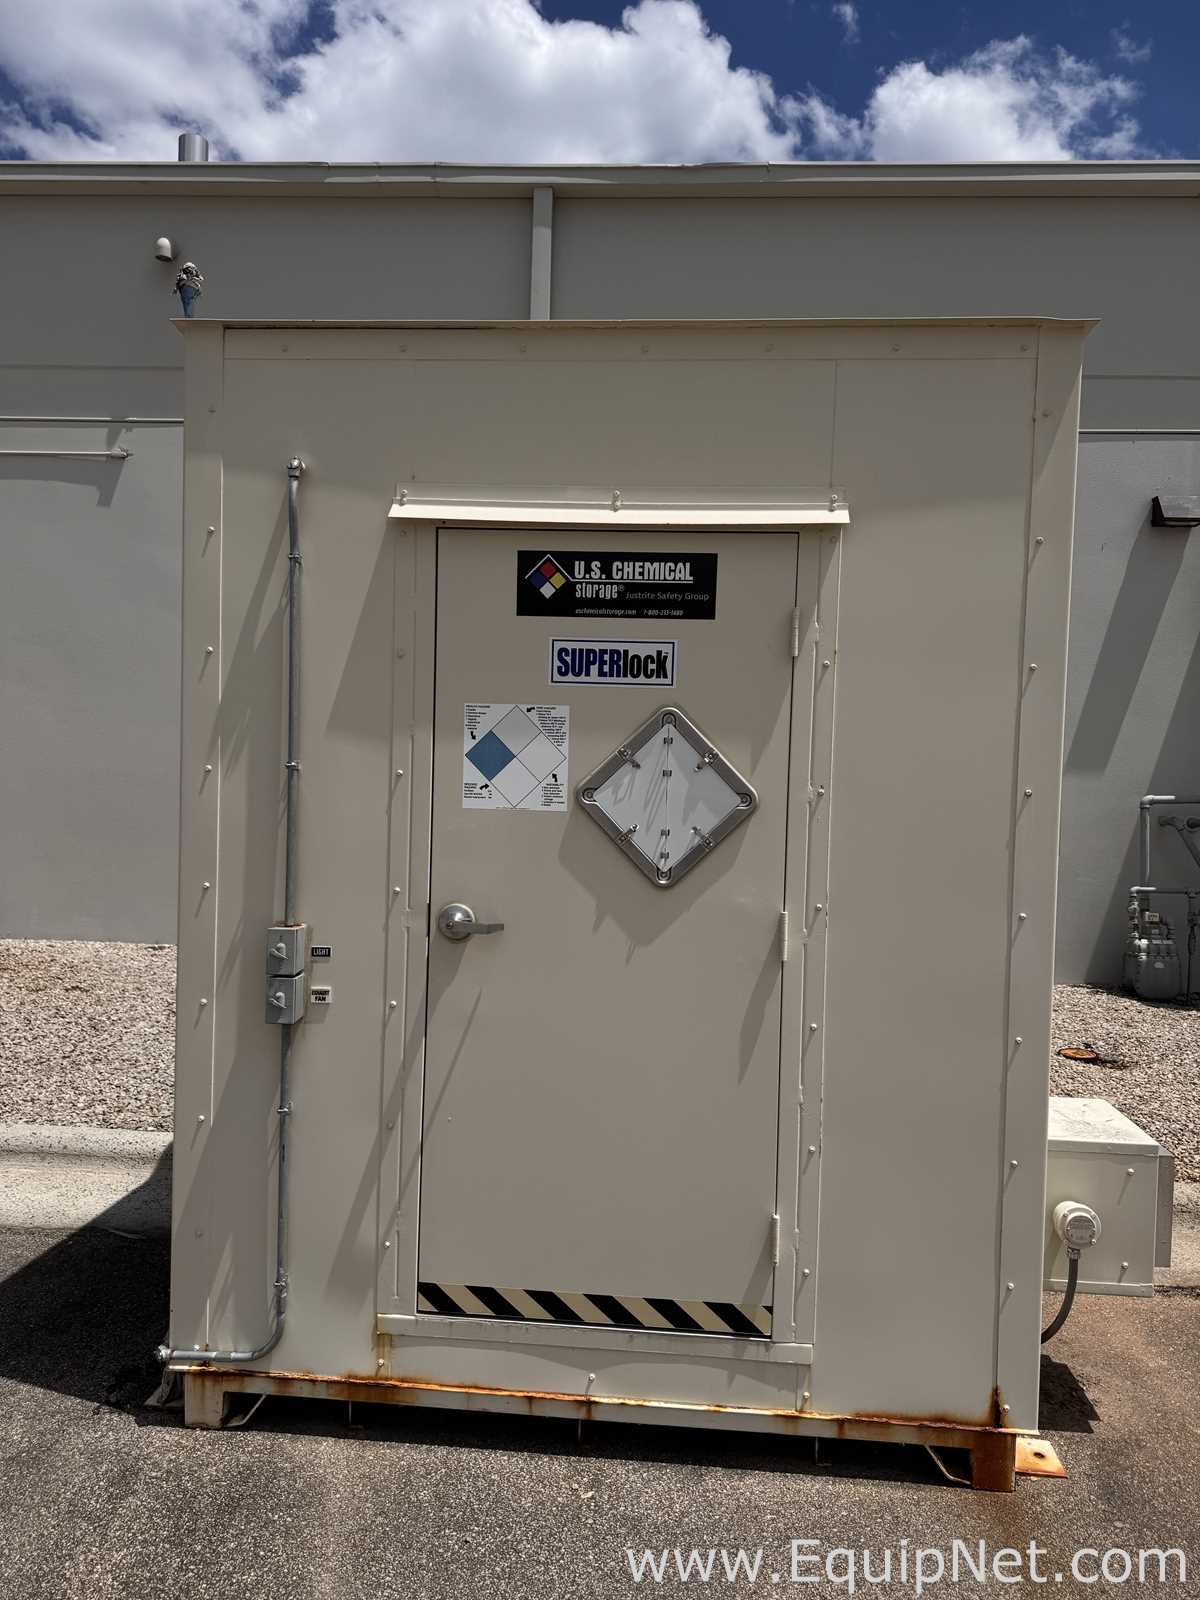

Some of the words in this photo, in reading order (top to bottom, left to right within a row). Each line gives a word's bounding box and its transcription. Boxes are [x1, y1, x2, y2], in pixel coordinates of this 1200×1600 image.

[574, 560, 606, 579] U.S.
[612, 561, 693, 581] CHEMICAL
[625, 591, 656, 600] Justrite
[657, 591, 683, 601] Safety
[685, 592, 710, 602] Group
[313, 948, 329, 956] LIGHT
